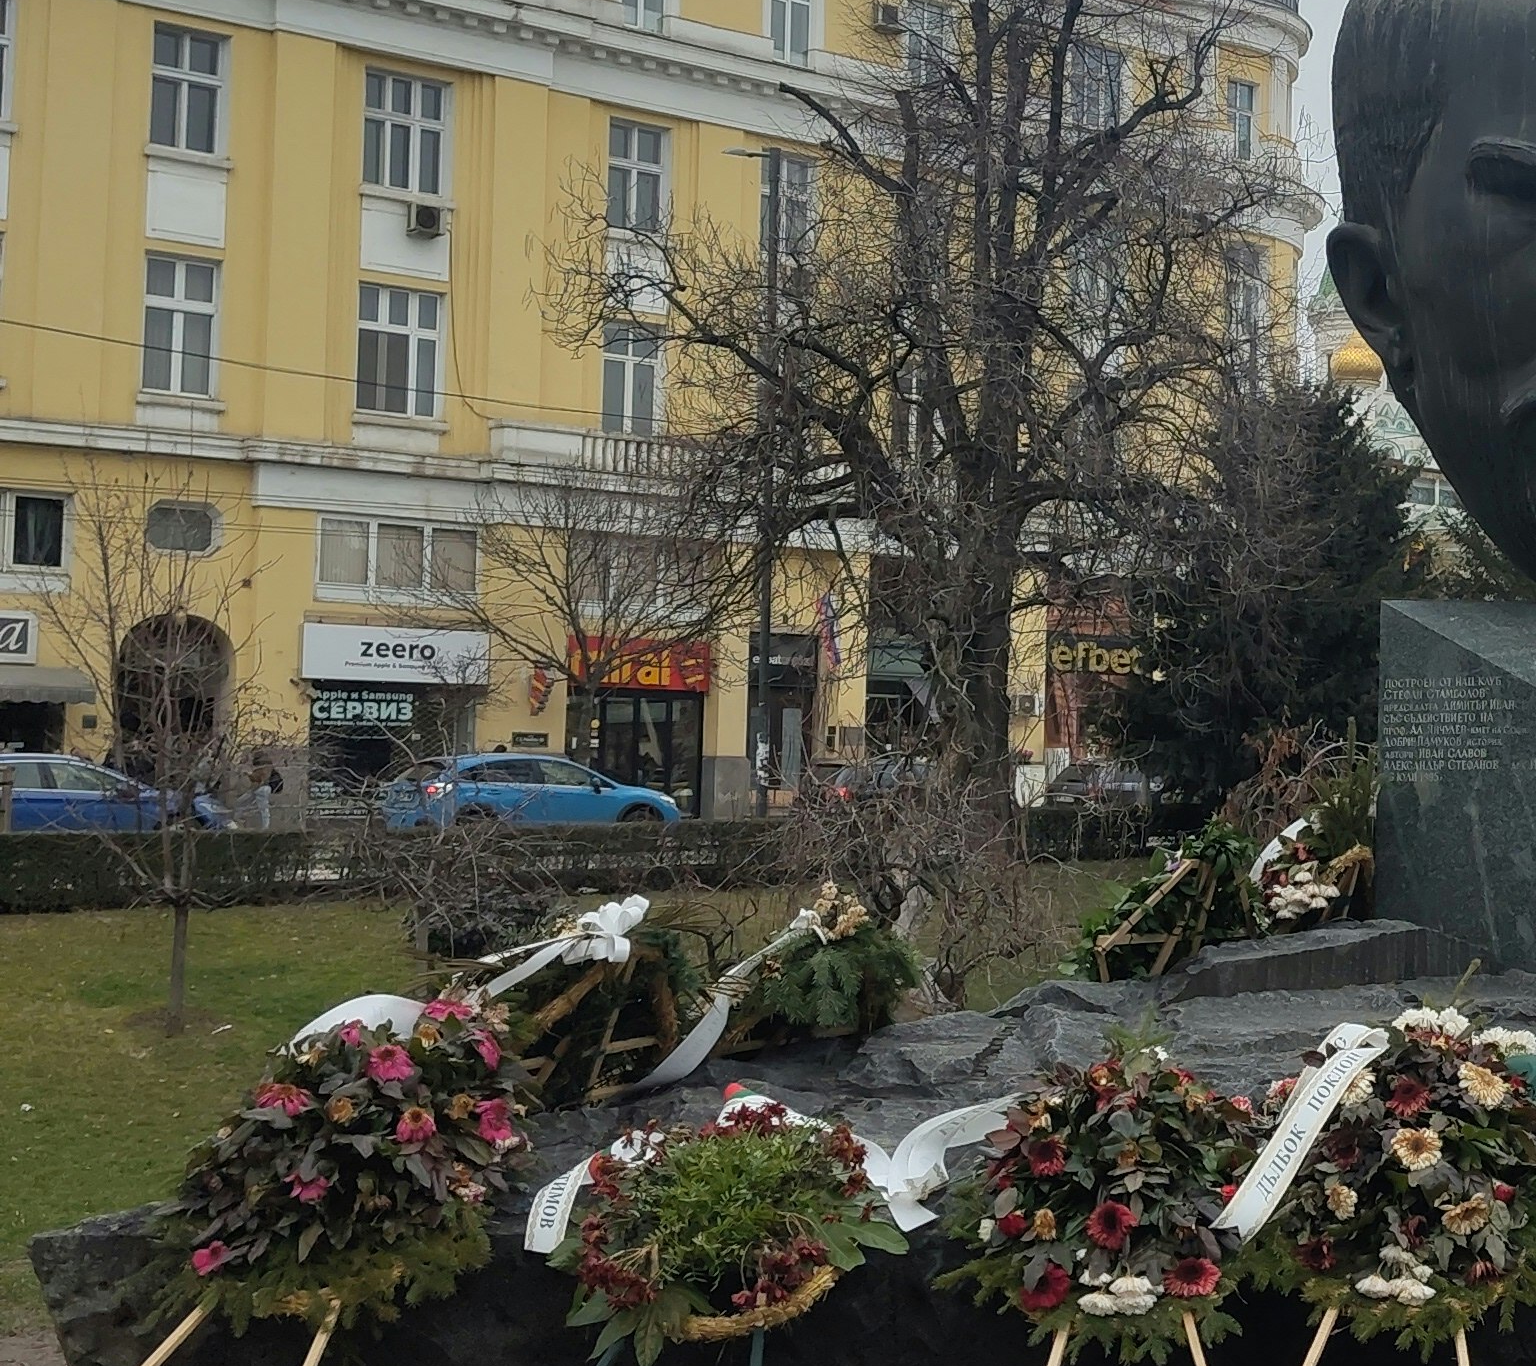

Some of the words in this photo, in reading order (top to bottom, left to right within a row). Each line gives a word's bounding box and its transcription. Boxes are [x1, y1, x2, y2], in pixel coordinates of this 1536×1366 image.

[360, 641, 436, 660] zeero
[1051, 640, 1143, 675] efbet
[1385, 678, 1435, 688] ПОСТРОЕН
[1440, 677, 1453, 687] ОТ
[314, 689, 348, 700] Apple
[362, 690, 414, 702] Samsung
[312, 700, 413, 720] СЕРВИЗ
[1442, 700, 1488, 710] ДИМИТЪР
[1480, 712, 1494, 723] НА
[1418, 748, 1444, 759] ИВАН
[1448, 748, 1487, 759] СЛАВОВ
[1383, 760, 1445, 771] АЛЕКСАНДЪР
[1255, 1123, 1307, 1203] ДЪЛБОК
[1307, 1051, 1362, 1112] ПОКЛОН
